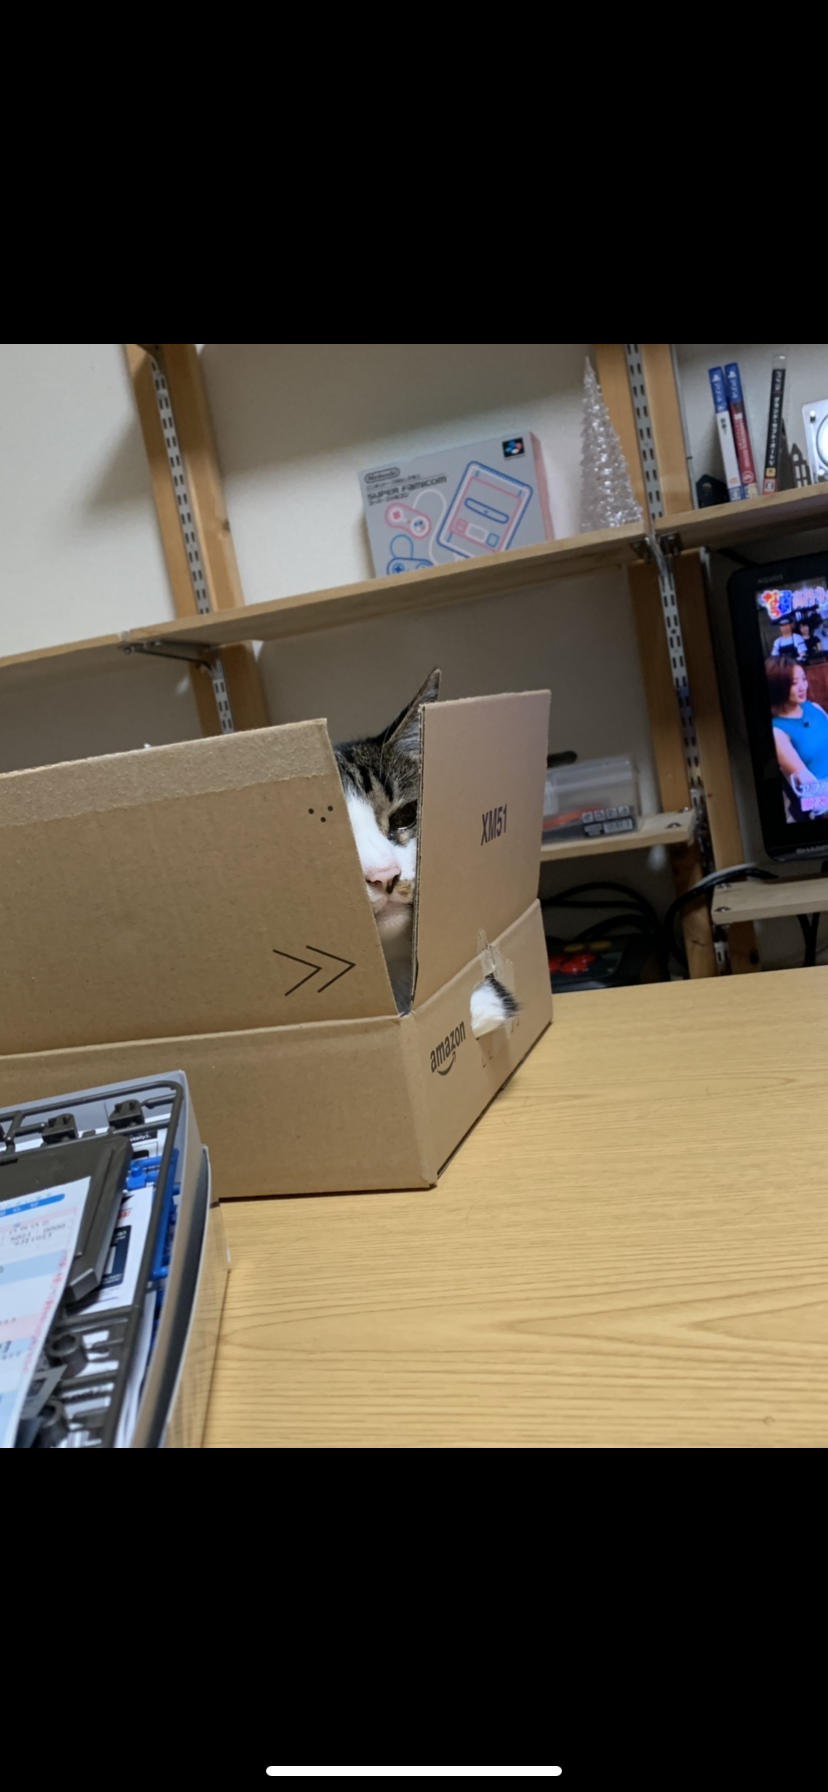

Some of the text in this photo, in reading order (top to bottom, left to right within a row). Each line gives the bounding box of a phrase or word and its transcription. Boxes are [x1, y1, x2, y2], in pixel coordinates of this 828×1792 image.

[714, 383, 723, 402] PS4
[729, 379, 739, 399] PS4
[367, 487, 400, 500] SUPER
[480, 803, 508, 846] XM51
[430, 1021, 466, 1073] amazon
